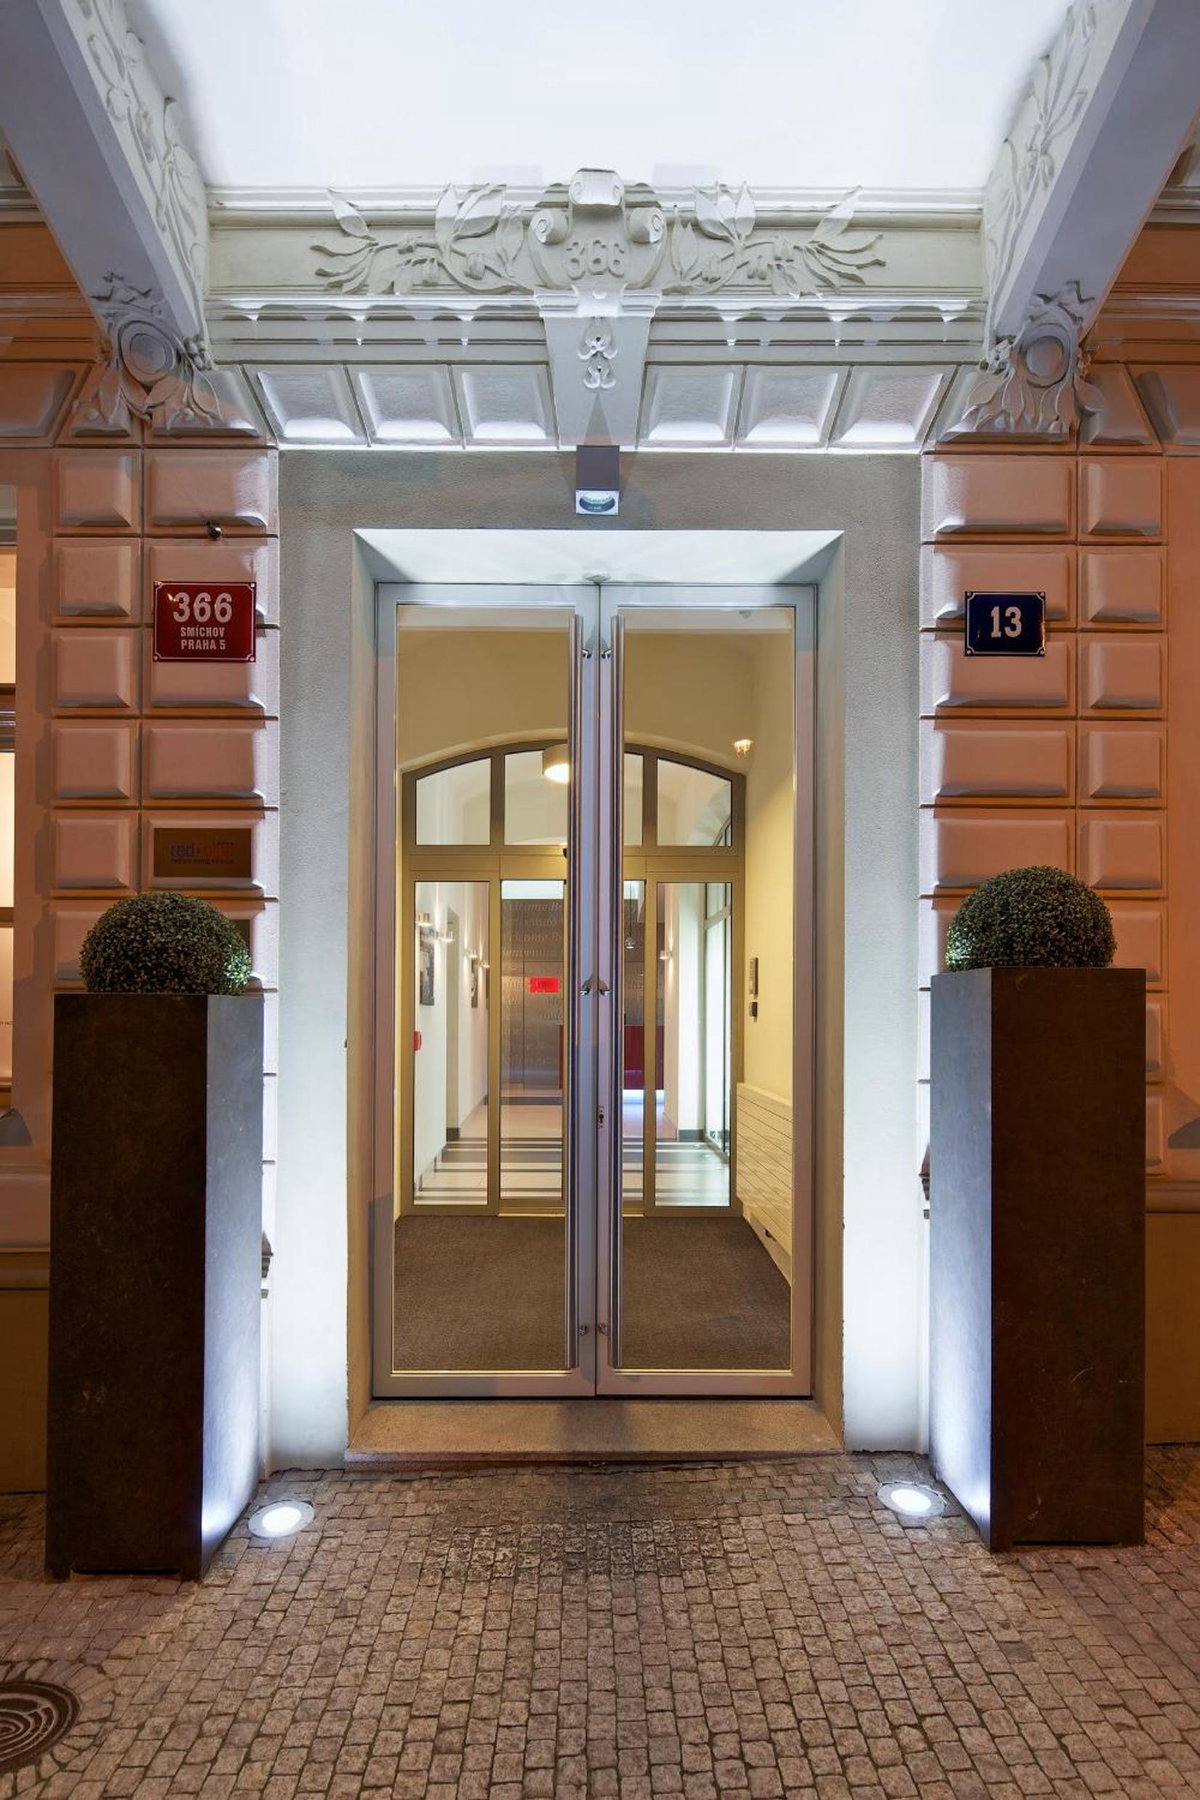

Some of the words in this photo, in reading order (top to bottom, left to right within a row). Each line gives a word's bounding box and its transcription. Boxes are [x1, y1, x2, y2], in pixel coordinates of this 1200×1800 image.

[565, 238, 626, 278] 366
[172, 591, 233, 624] 366
[990, 605, 1022, 638] 13
[180, 624, 225, 638] SMÍCHOV
[180, 639, 217, 650] PRAHA
[219, 639, 226, 650] 5
